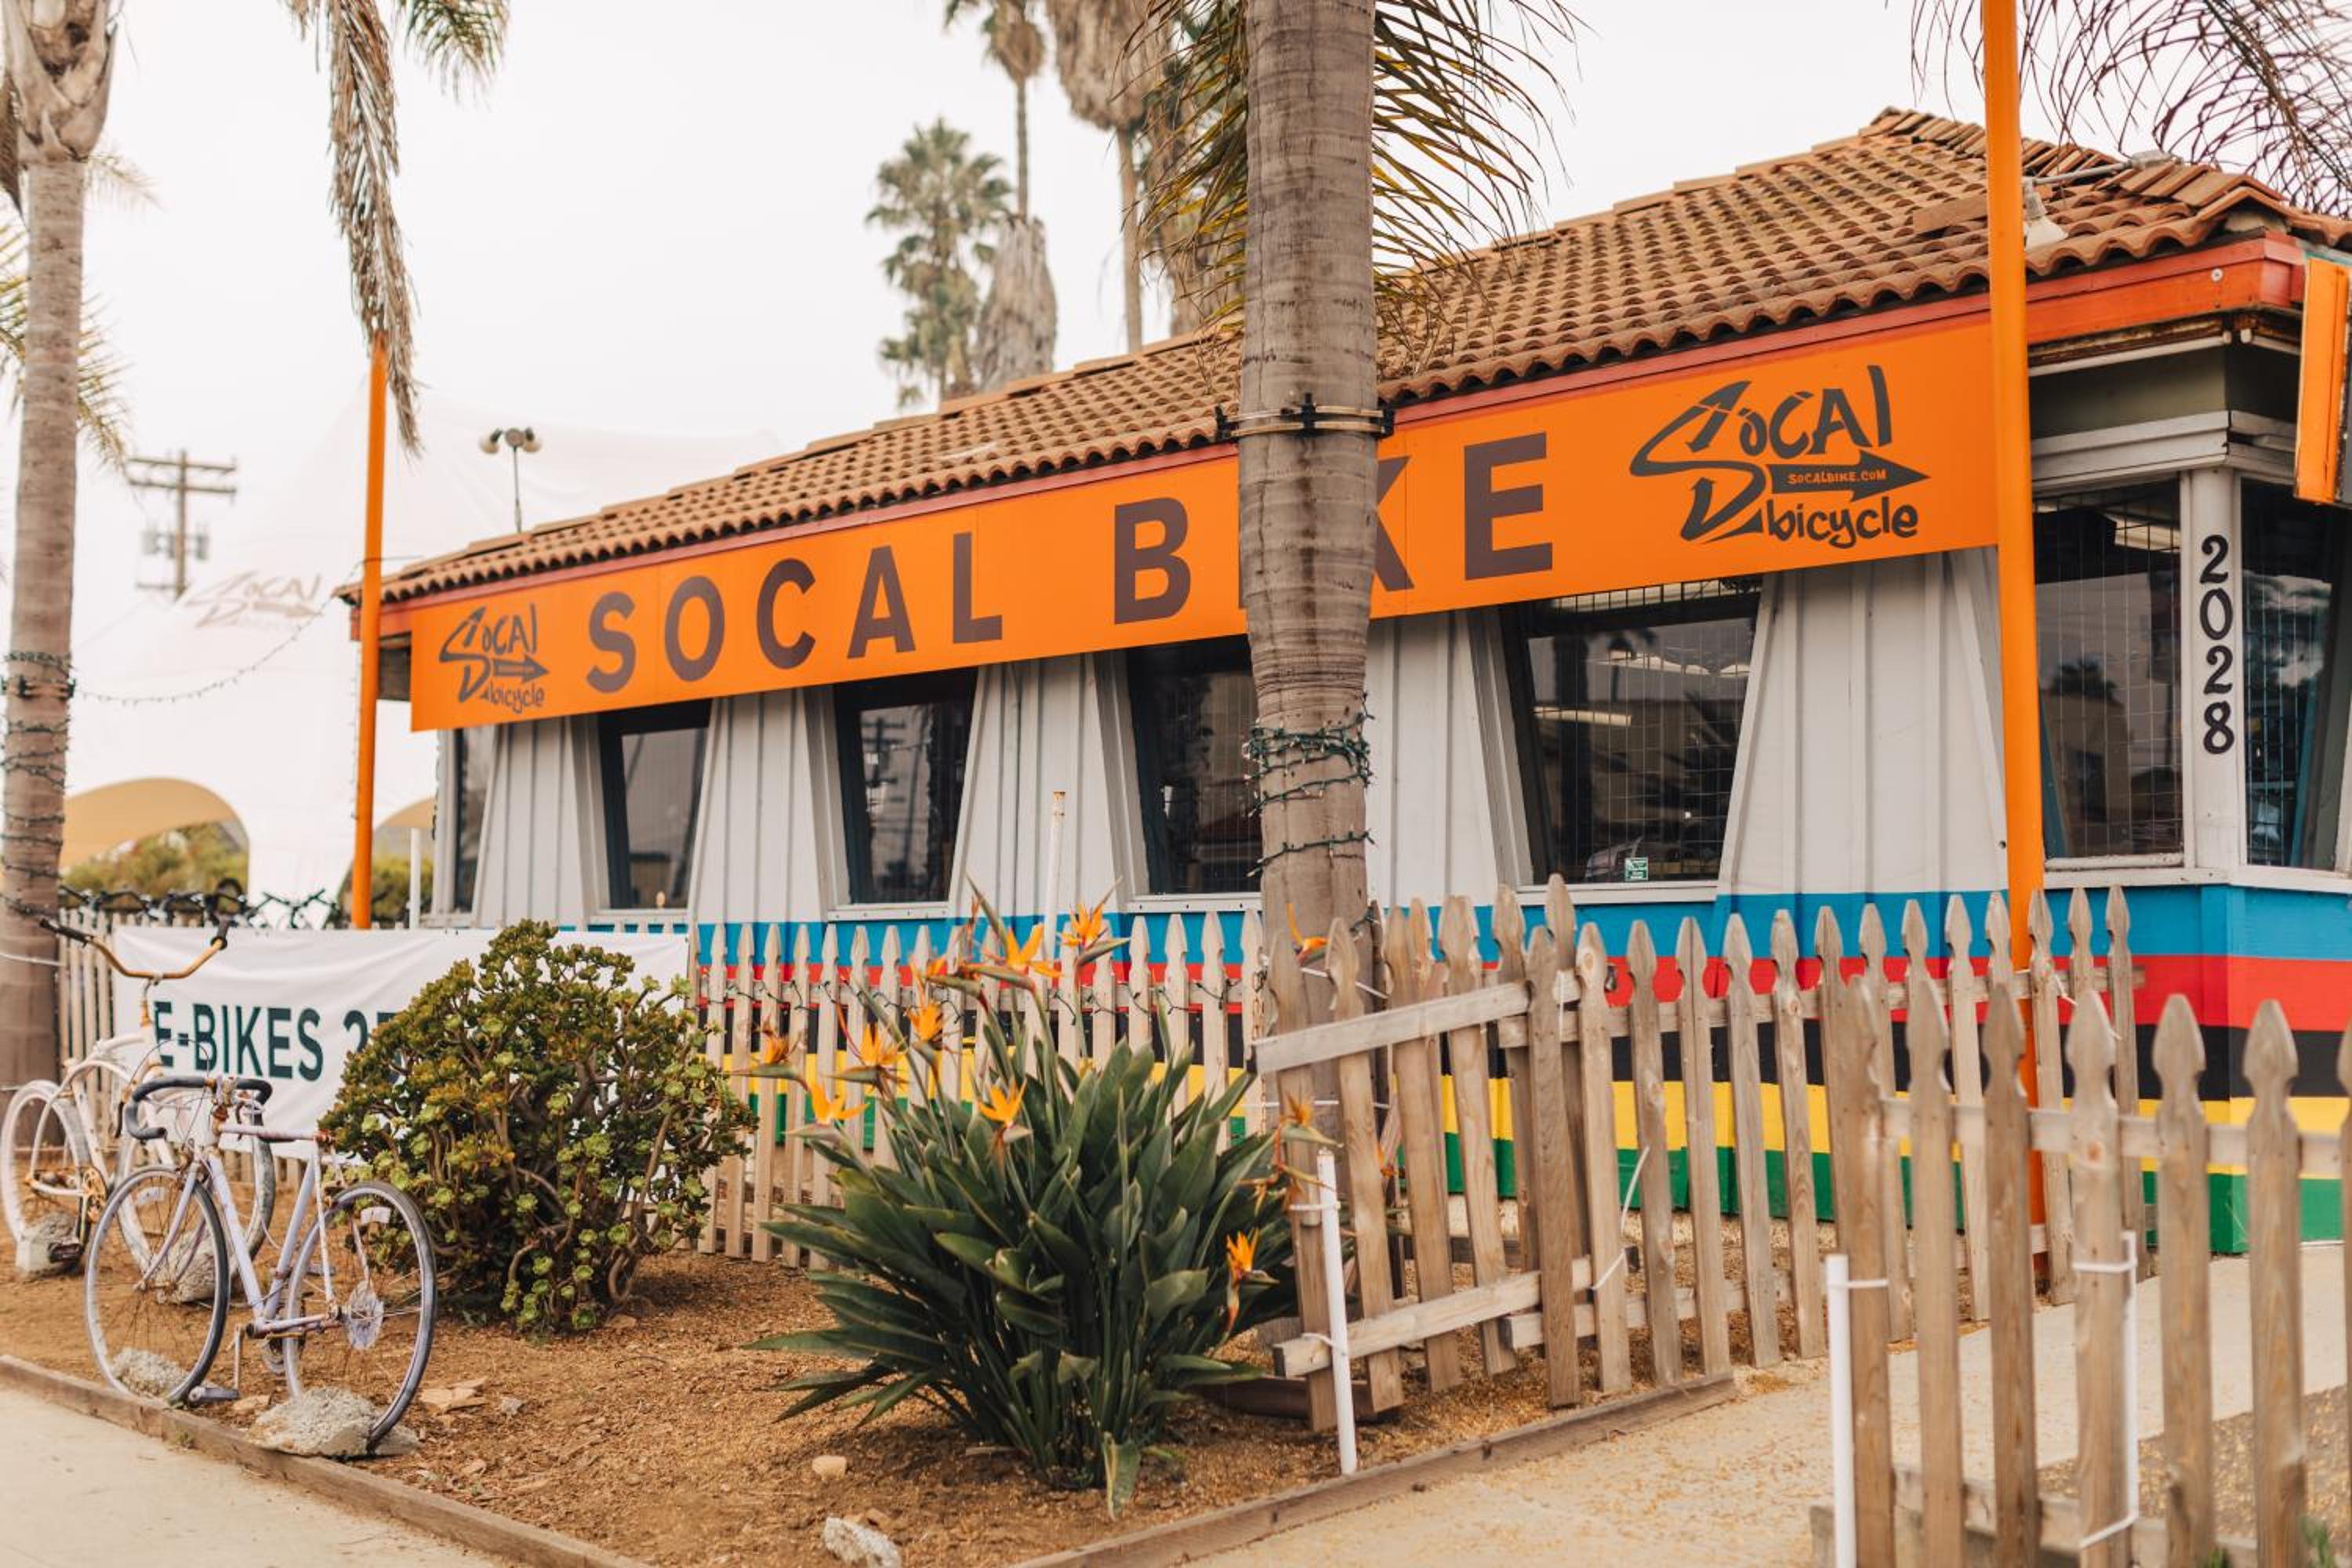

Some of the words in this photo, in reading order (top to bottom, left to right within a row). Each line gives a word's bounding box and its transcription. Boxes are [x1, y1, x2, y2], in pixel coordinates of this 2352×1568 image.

[586, 532, 1003, 693] SOCAL
[1114, 432, 1553, 625] BE
[1766, 496, 1918, 549] bicycle
[2199, 534, 2234, 754] 2028
[154, 1000, 324, 1082] E-BIKES
